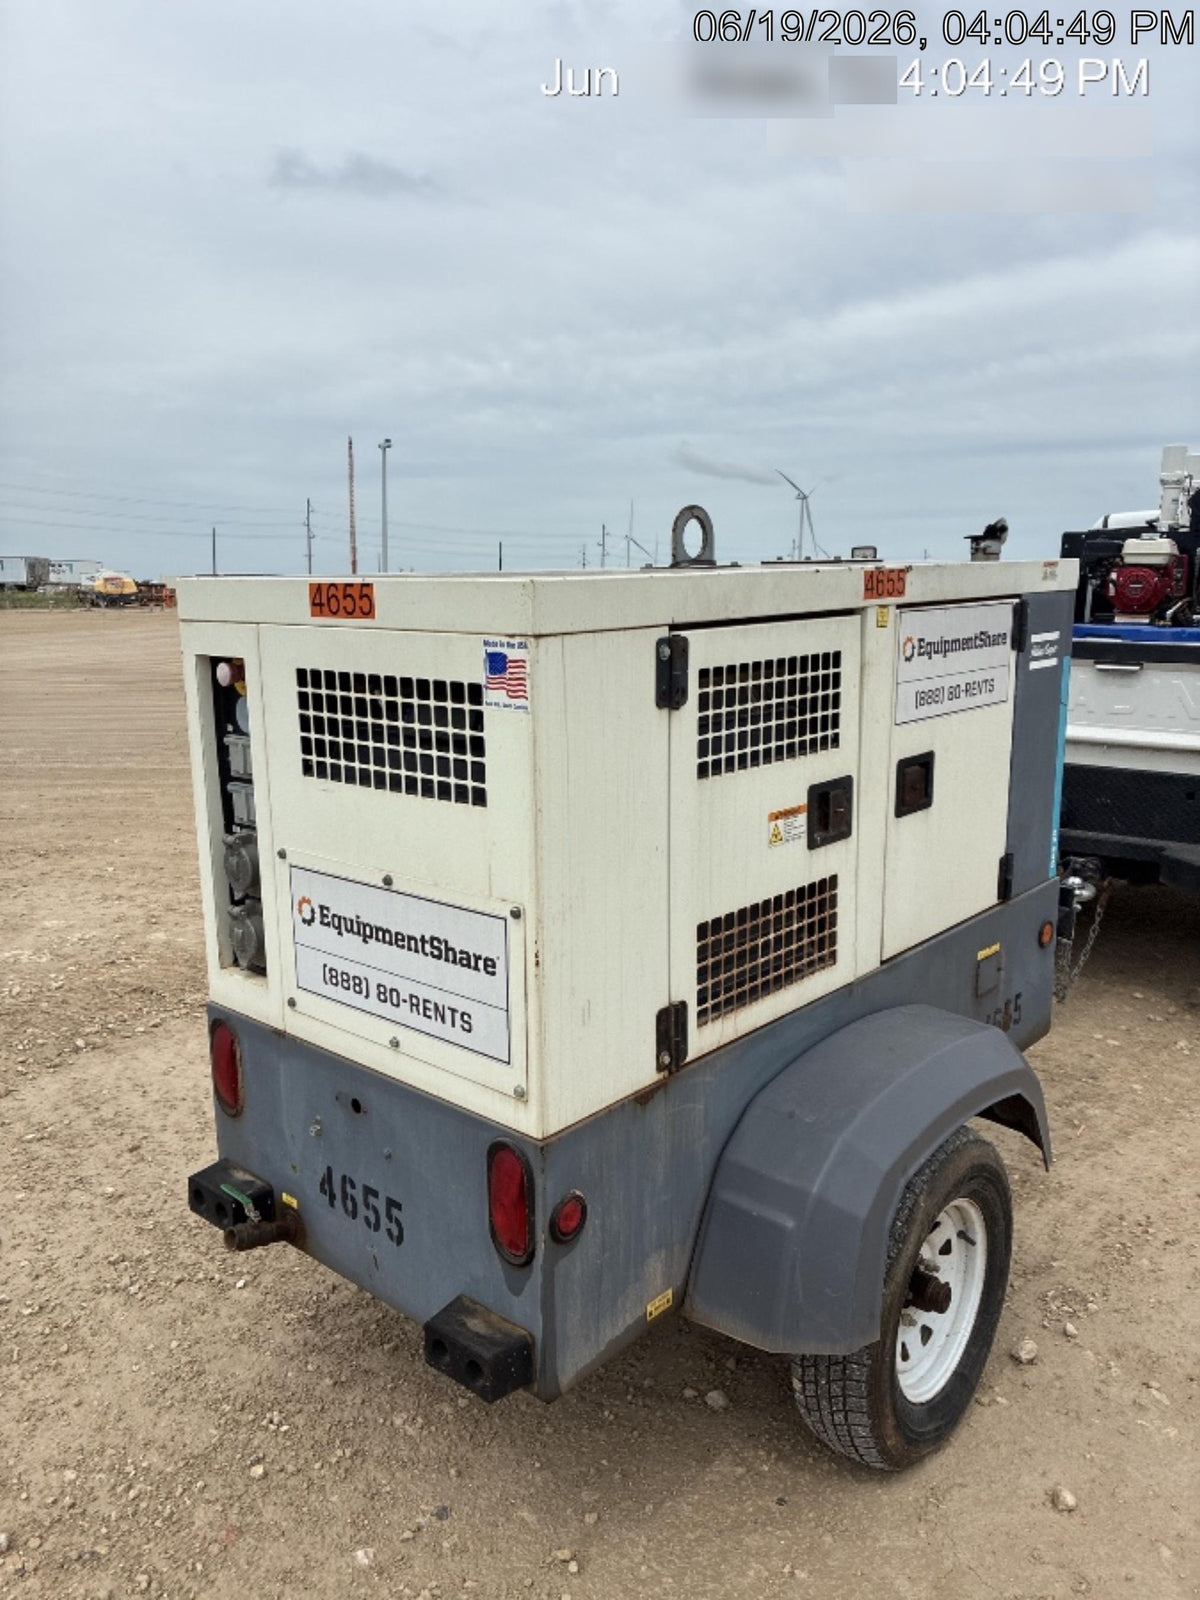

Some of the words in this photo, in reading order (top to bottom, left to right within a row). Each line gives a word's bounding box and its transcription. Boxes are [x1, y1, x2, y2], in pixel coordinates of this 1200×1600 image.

[311, 583, 373, 616] 4655
[865, 569, 905, 597] 4655
[917, 631, 1007, 659] EquipmentShare
[915, 687, 945, 709] (888)
[947, 679, 995, 701] 80-RENTS
[319, 904, 496, 976] EquipmentShare
[322, 963, 370, 999] (888)
[376, 982, 473, 1034] 80-RENTS
[319, 1166, 404, 1247] 4655
